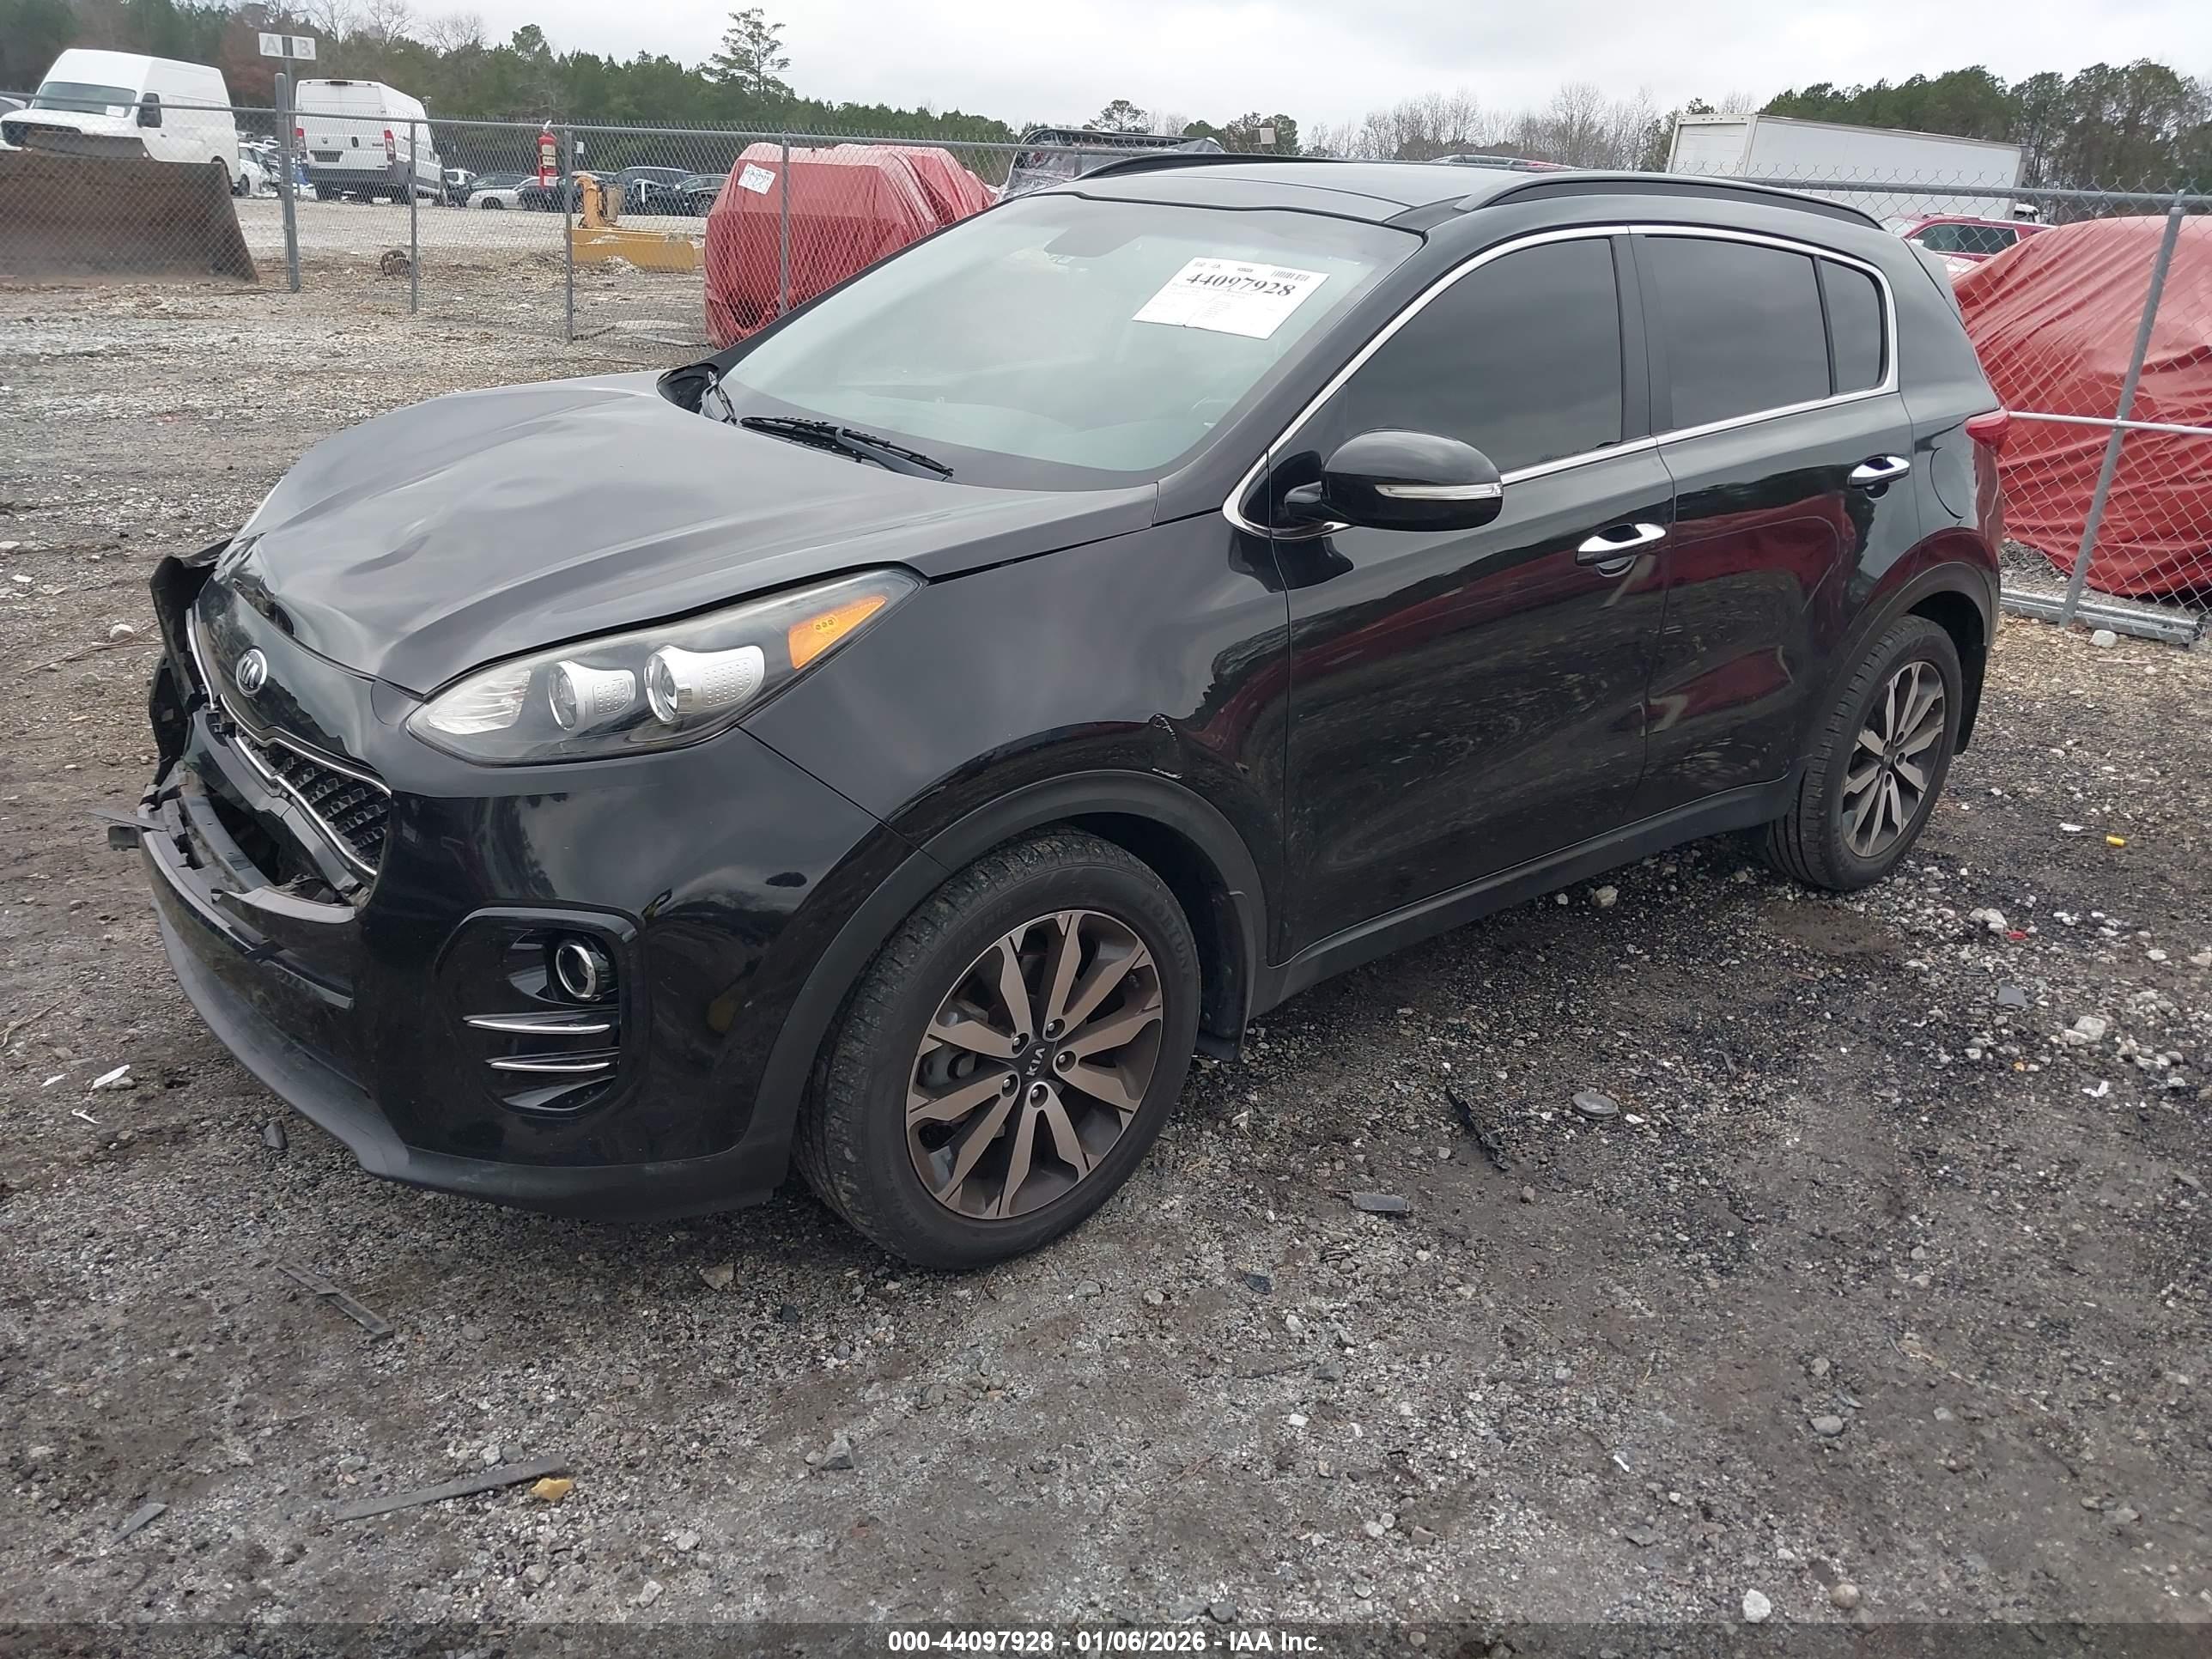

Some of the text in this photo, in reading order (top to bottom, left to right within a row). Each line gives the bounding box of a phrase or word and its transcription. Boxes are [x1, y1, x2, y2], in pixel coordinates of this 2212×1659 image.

[263, 36, 311, 57] A B
[1186, 272, 1297, 297] 44097928
[1025, 1047, 1046, 1077] KIA
